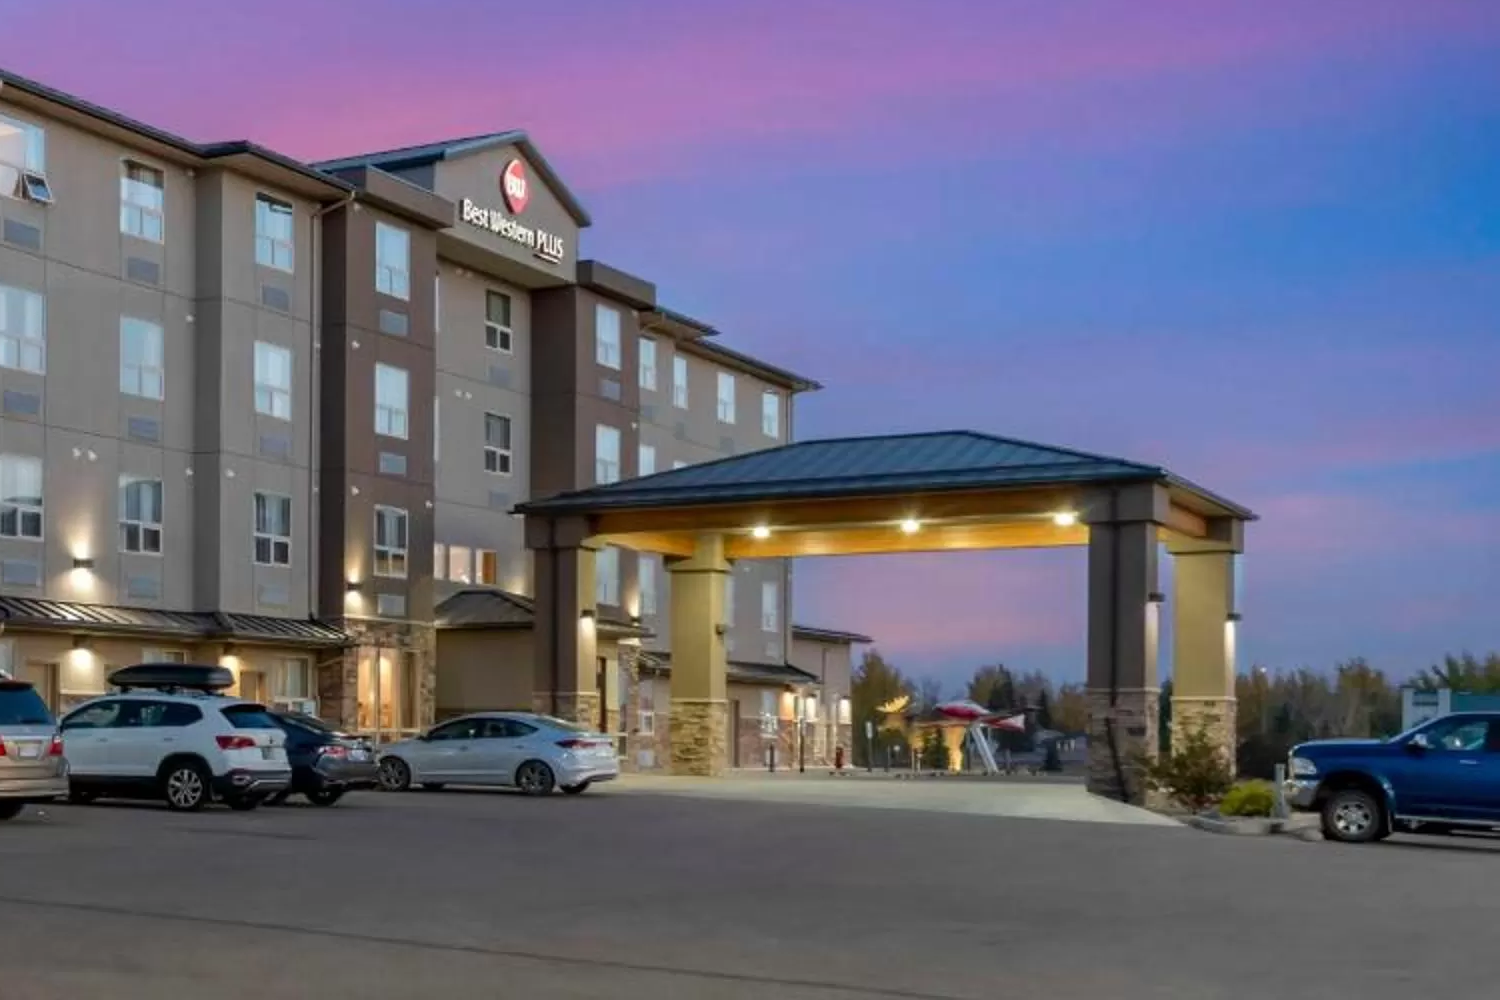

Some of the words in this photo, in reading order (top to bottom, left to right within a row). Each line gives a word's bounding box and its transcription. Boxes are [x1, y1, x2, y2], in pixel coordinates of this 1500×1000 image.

[462, 198, 489, 228] Best
[490, 210, 535, 247] Western
[536, 228, 564, 259] PLUS
